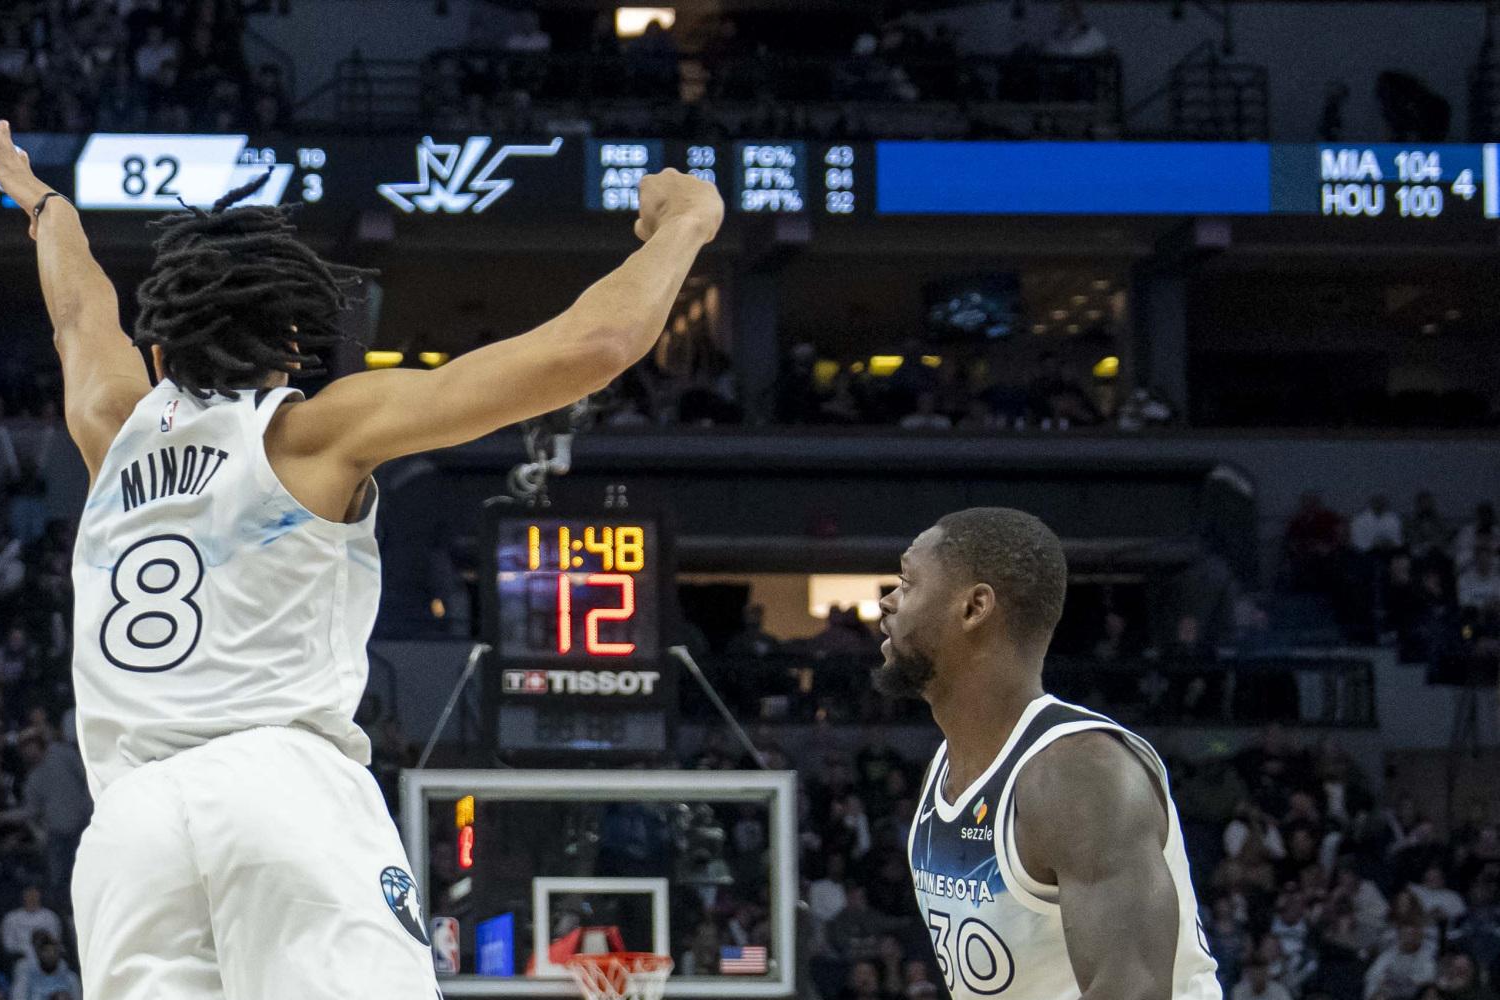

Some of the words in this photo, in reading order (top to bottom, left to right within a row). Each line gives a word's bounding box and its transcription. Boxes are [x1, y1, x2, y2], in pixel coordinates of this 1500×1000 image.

[123, 154, 181, 196] 82
[1321, 149, 1383, 182] MIA
[1394, 150, 1442, 183] 104
[1451, 168, 1477, 200] 4
[302, 173, 323, 201] 3
[1322, 183, 1385, 216] HOU
[1394, 185, 1443, 217] 100
[121, 444, 229, 513] MINOTT
[528, 526, 644, 571] 11:48
[100, 533, 204, 673] 8
[557, 573, 636, 656] 12
[548, 671, 660, 694] TISSOT
[961, 824, 993, 841] sezzle
[928, 908, 1016, 996] 30
